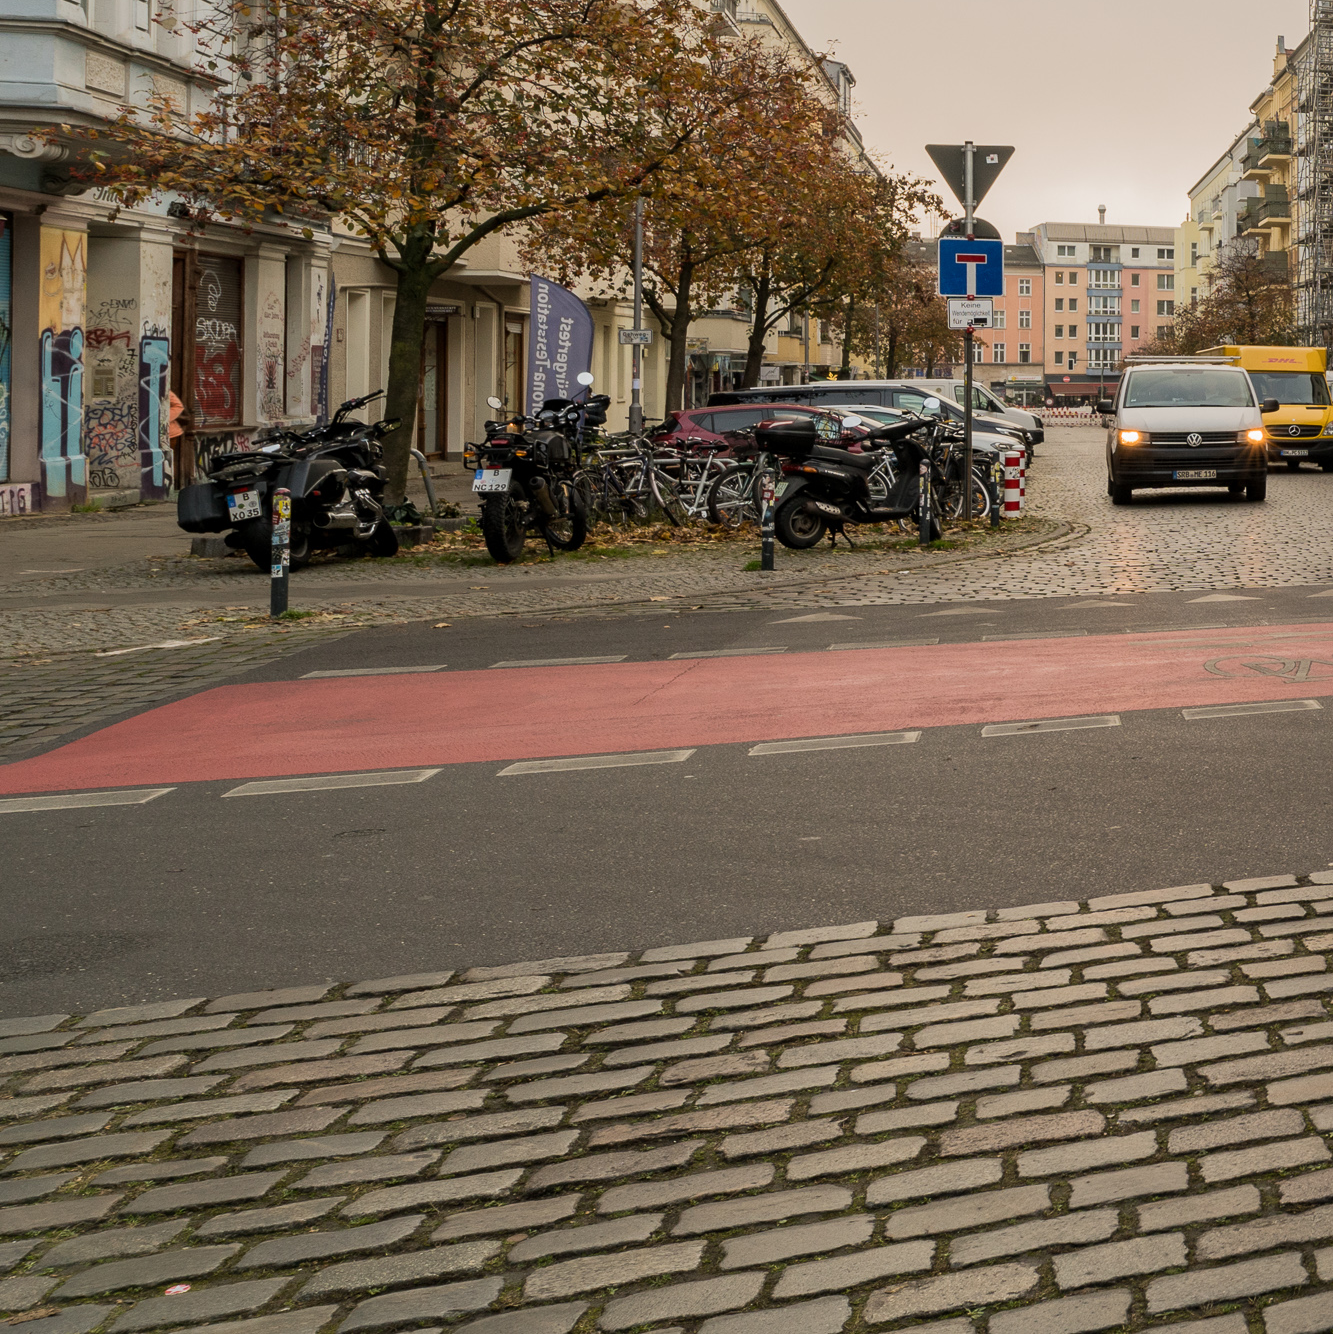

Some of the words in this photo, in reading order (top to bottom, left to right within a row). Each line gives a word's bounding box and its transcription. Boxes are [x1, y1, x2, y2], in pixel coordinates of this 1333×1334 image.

[242, 493, 249, 501] B
[232, 511, 246, 521] XO
[247, 508, 260, 518] 35
